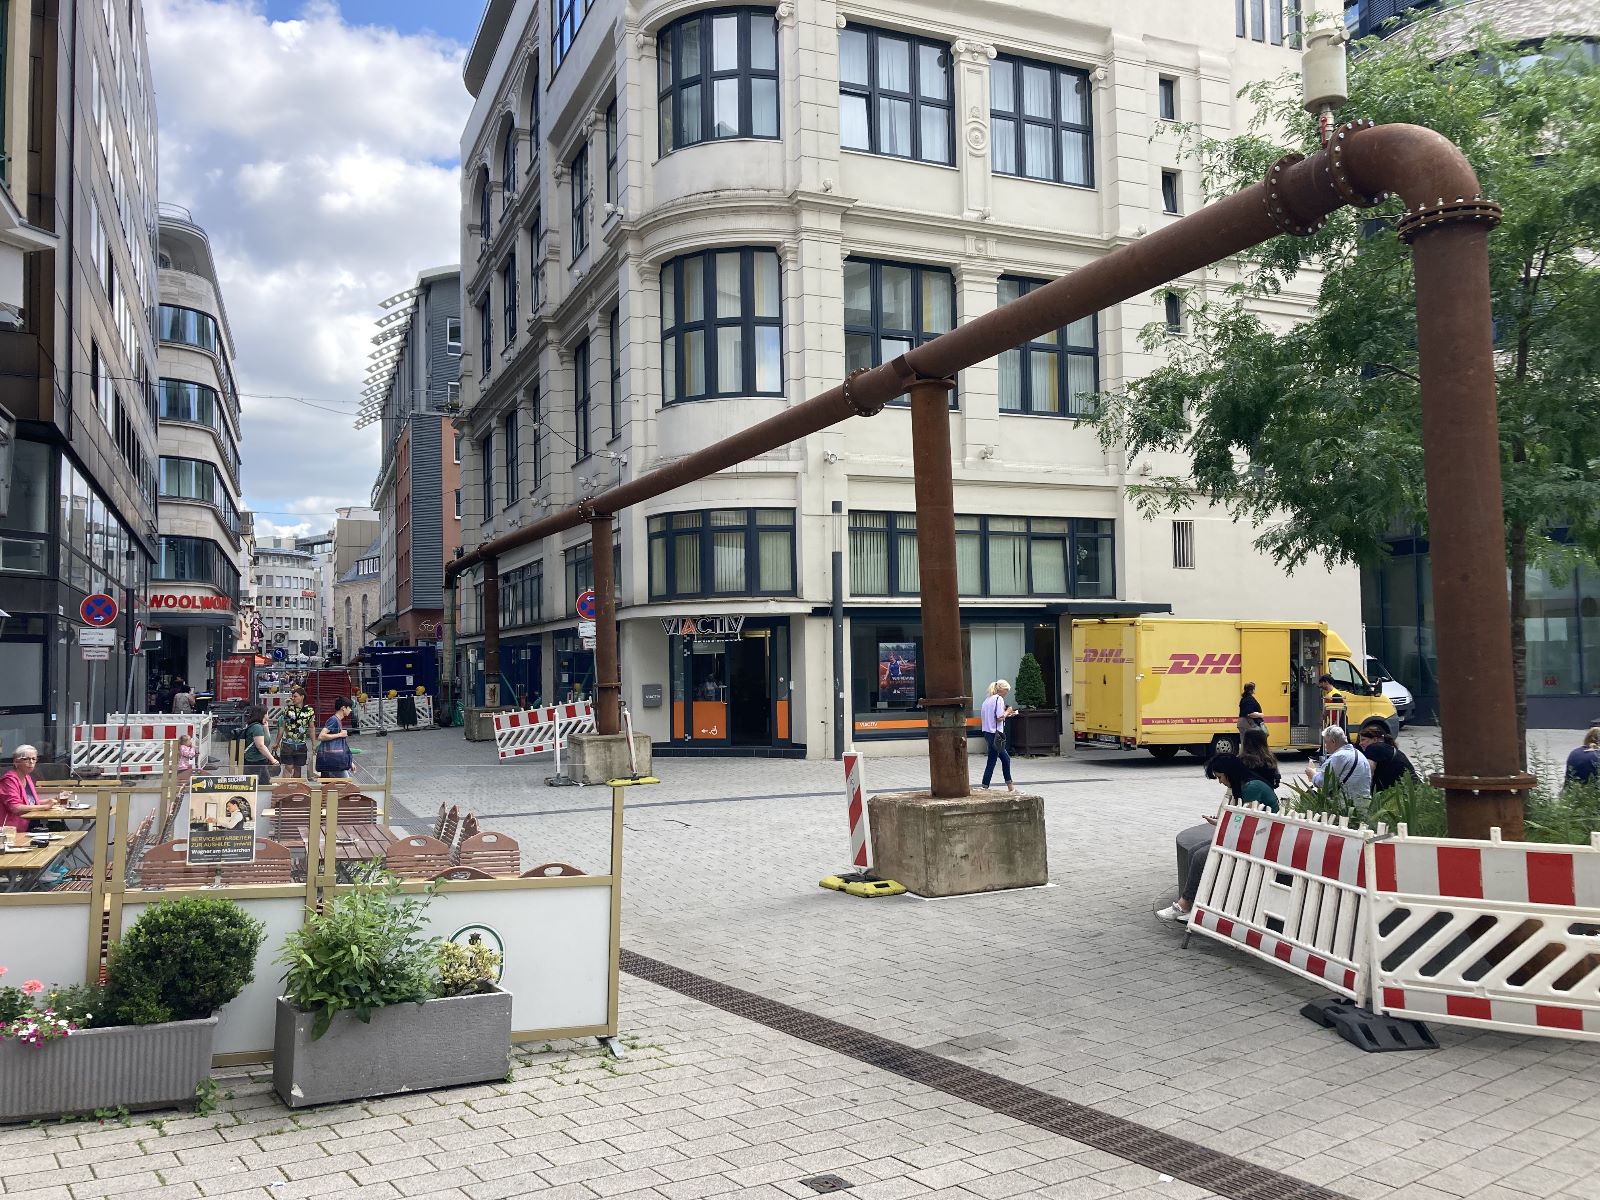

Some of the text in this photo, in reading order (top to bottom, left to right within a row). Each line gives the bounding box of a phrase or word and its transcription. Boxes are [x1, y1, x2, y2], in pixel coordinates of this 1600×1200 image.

[659, 614, 745, 636] VIACTIV
[1081, 648, 1126, 664] DHL
[1167, 653, 1241, 675] DHL
